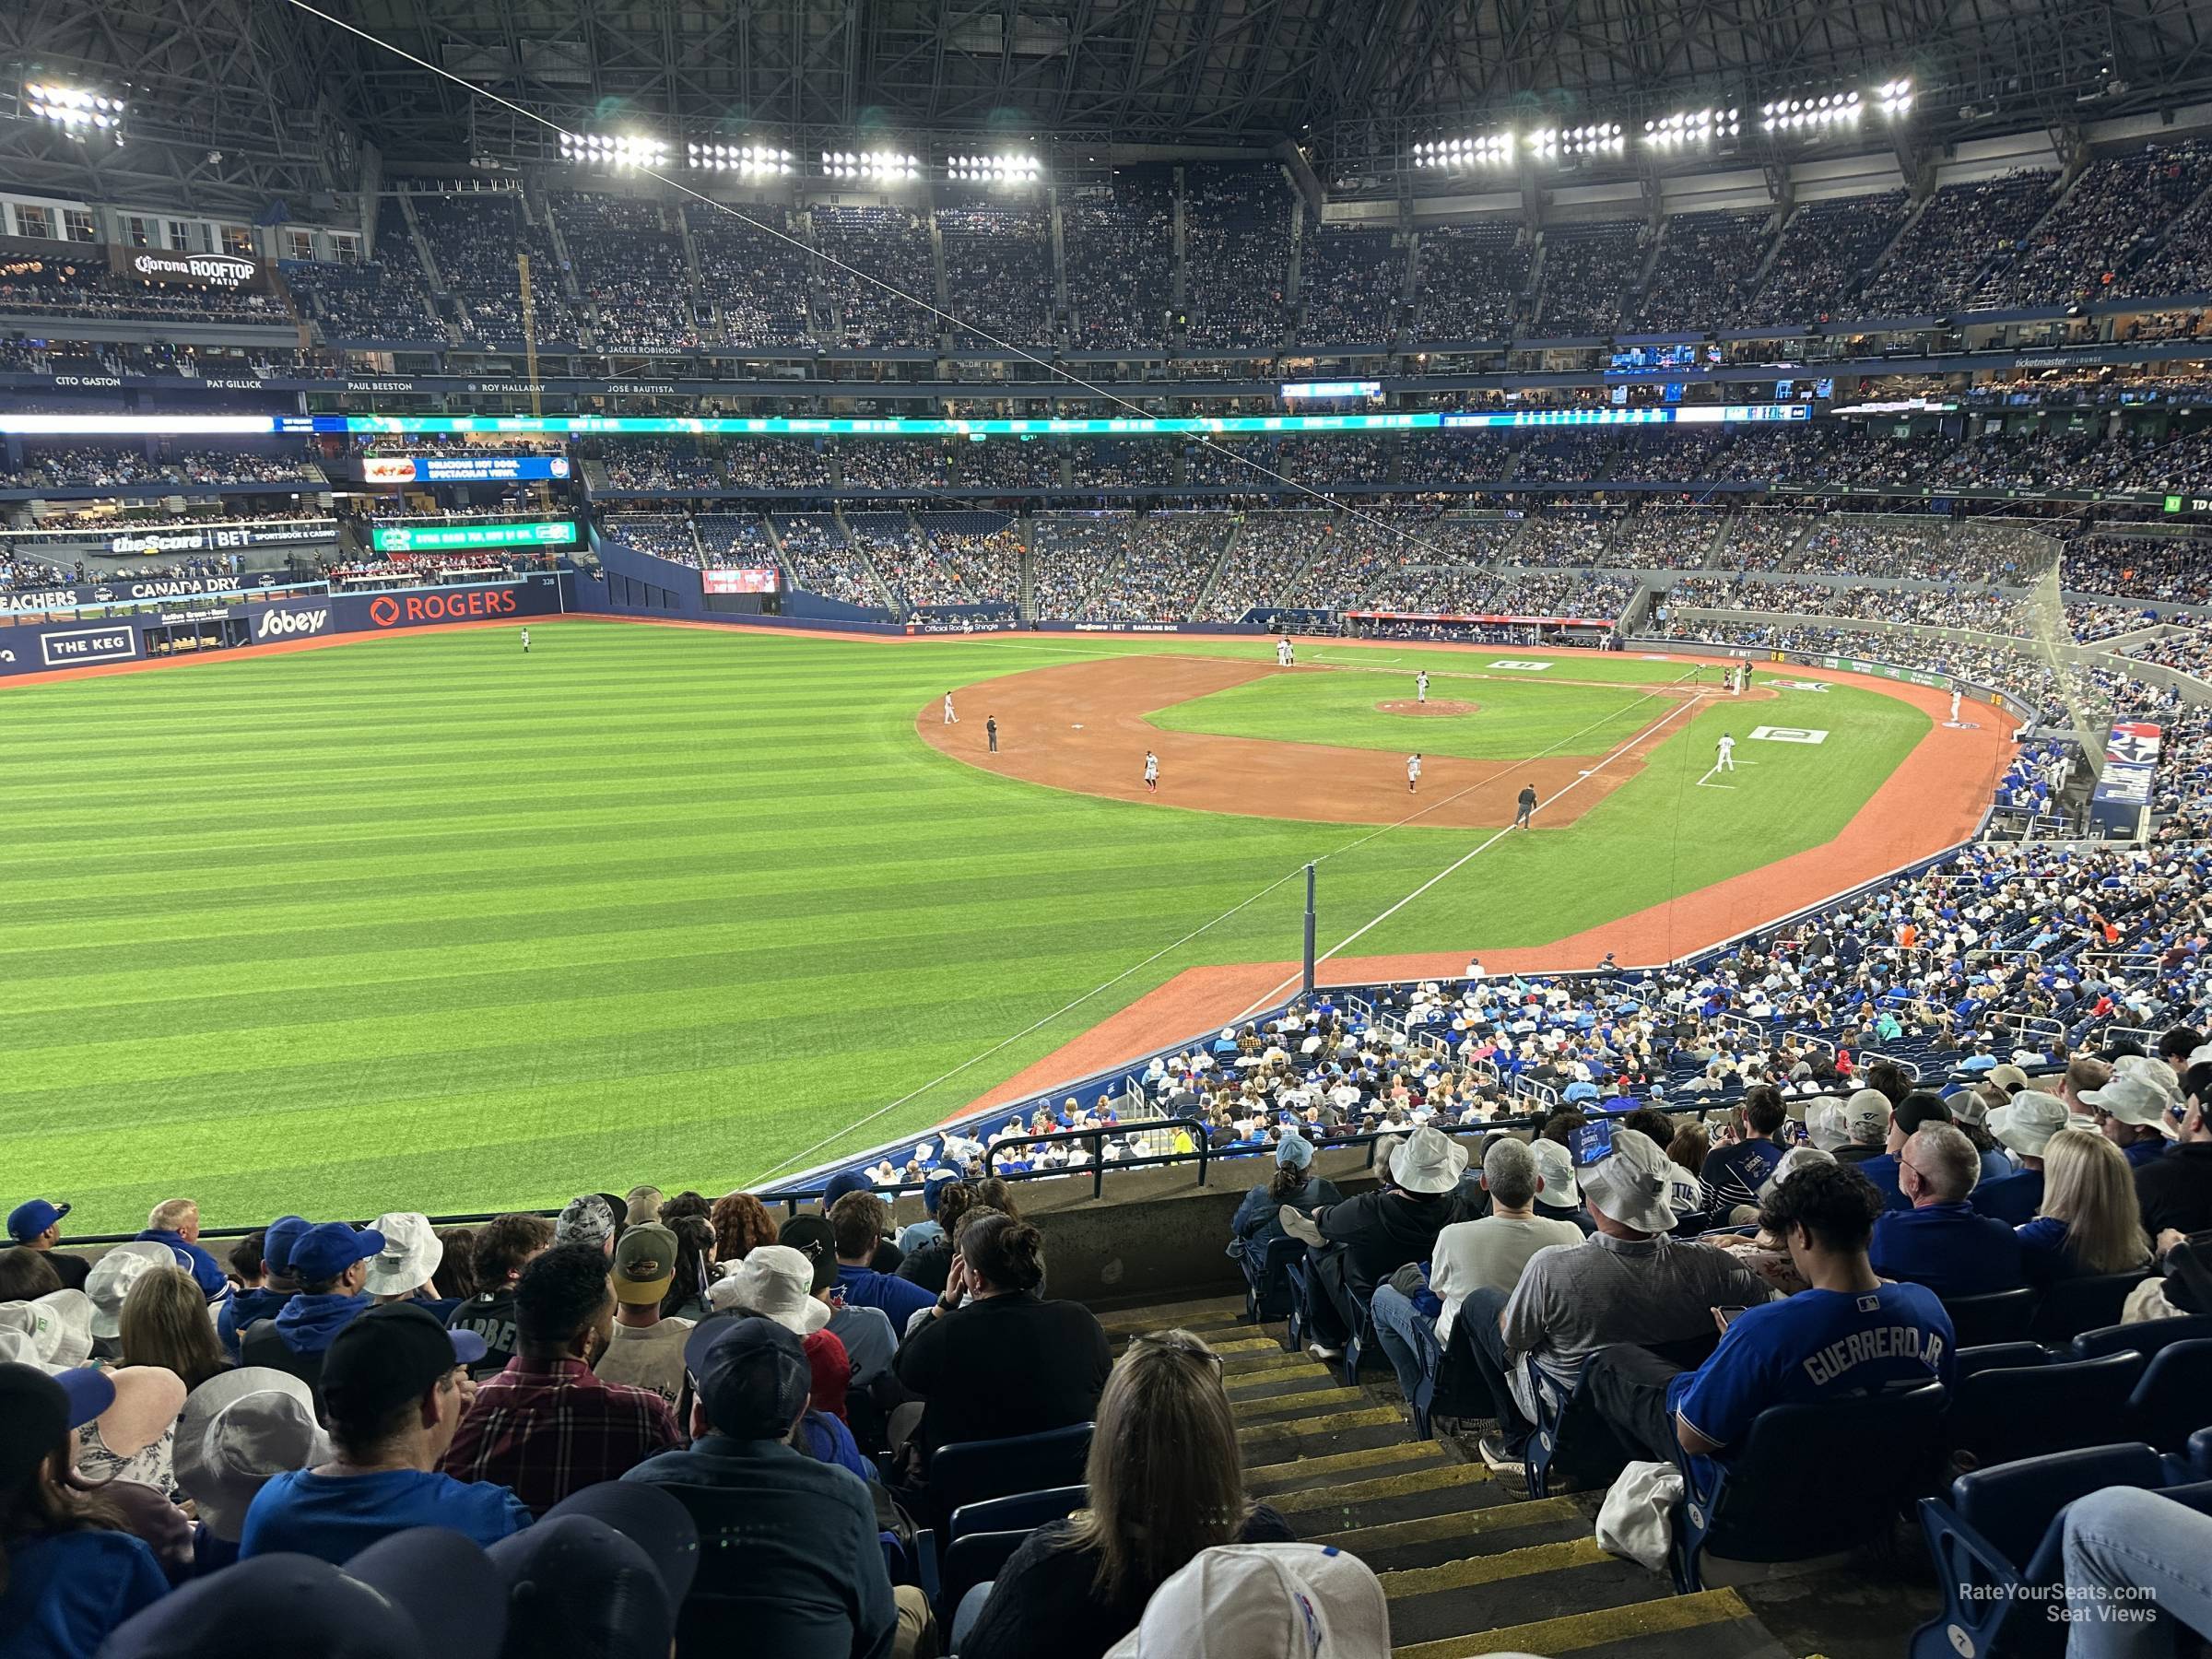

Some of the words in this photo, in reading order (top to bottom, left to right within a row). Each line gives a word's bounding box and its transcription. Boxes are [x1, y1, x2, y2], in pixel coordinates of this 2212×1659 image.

[135, 255, 189, 275] Corona
[190, 260, 254, 280] ROOFTOP
[210, 277, 239, 287] PATIO
[608, 346, 637, 355] JACKIE
[639, 346, 681, 355] ROBINSON
[2015, 358, 2067, 368] ticketmaster
[2076, 356, 2102, 364] LOUNGE
[56, 376, 78, 386] CITO
[82, 376, 121, 386] GASTON
[206, 379, 223, 388] PAT
[226, 380, 262, 389] GILLICK
[347, 382, 371, 391] PAUL
[372, 382, 412, 391] BEESTON
[482, 383, 500, 392] ROY
[607, 383, 630, 393] JOSÉ
[633, 385, 674, 394] BAUTISTA
[2192, 500, 2207, 511] TD
[112, 535, 203, 553] theScore
[218, 530, 251, 547] BET
[255, 532, 302, 541] SPORTSBOOK
[310, 530, 335, 538] CASINO
[131, 581, 202, 598] CANADA
[207, 576, 241, 593] DRY.
[542, 578, 555, 586] 328
[0, 591, 77, 611] EACHERS
[406, 590, 516, 620] ROGERS
[258, 608, 327, 638] Sobeys
[974, 624, 999, 632] Shingle
[53, 641, 88, 654] THE
[92, 636, 124, 650] KEG
[1803, 1326, 1920, 1385] GUERRERO
[1919, 1333, 1943, 1368] JR
